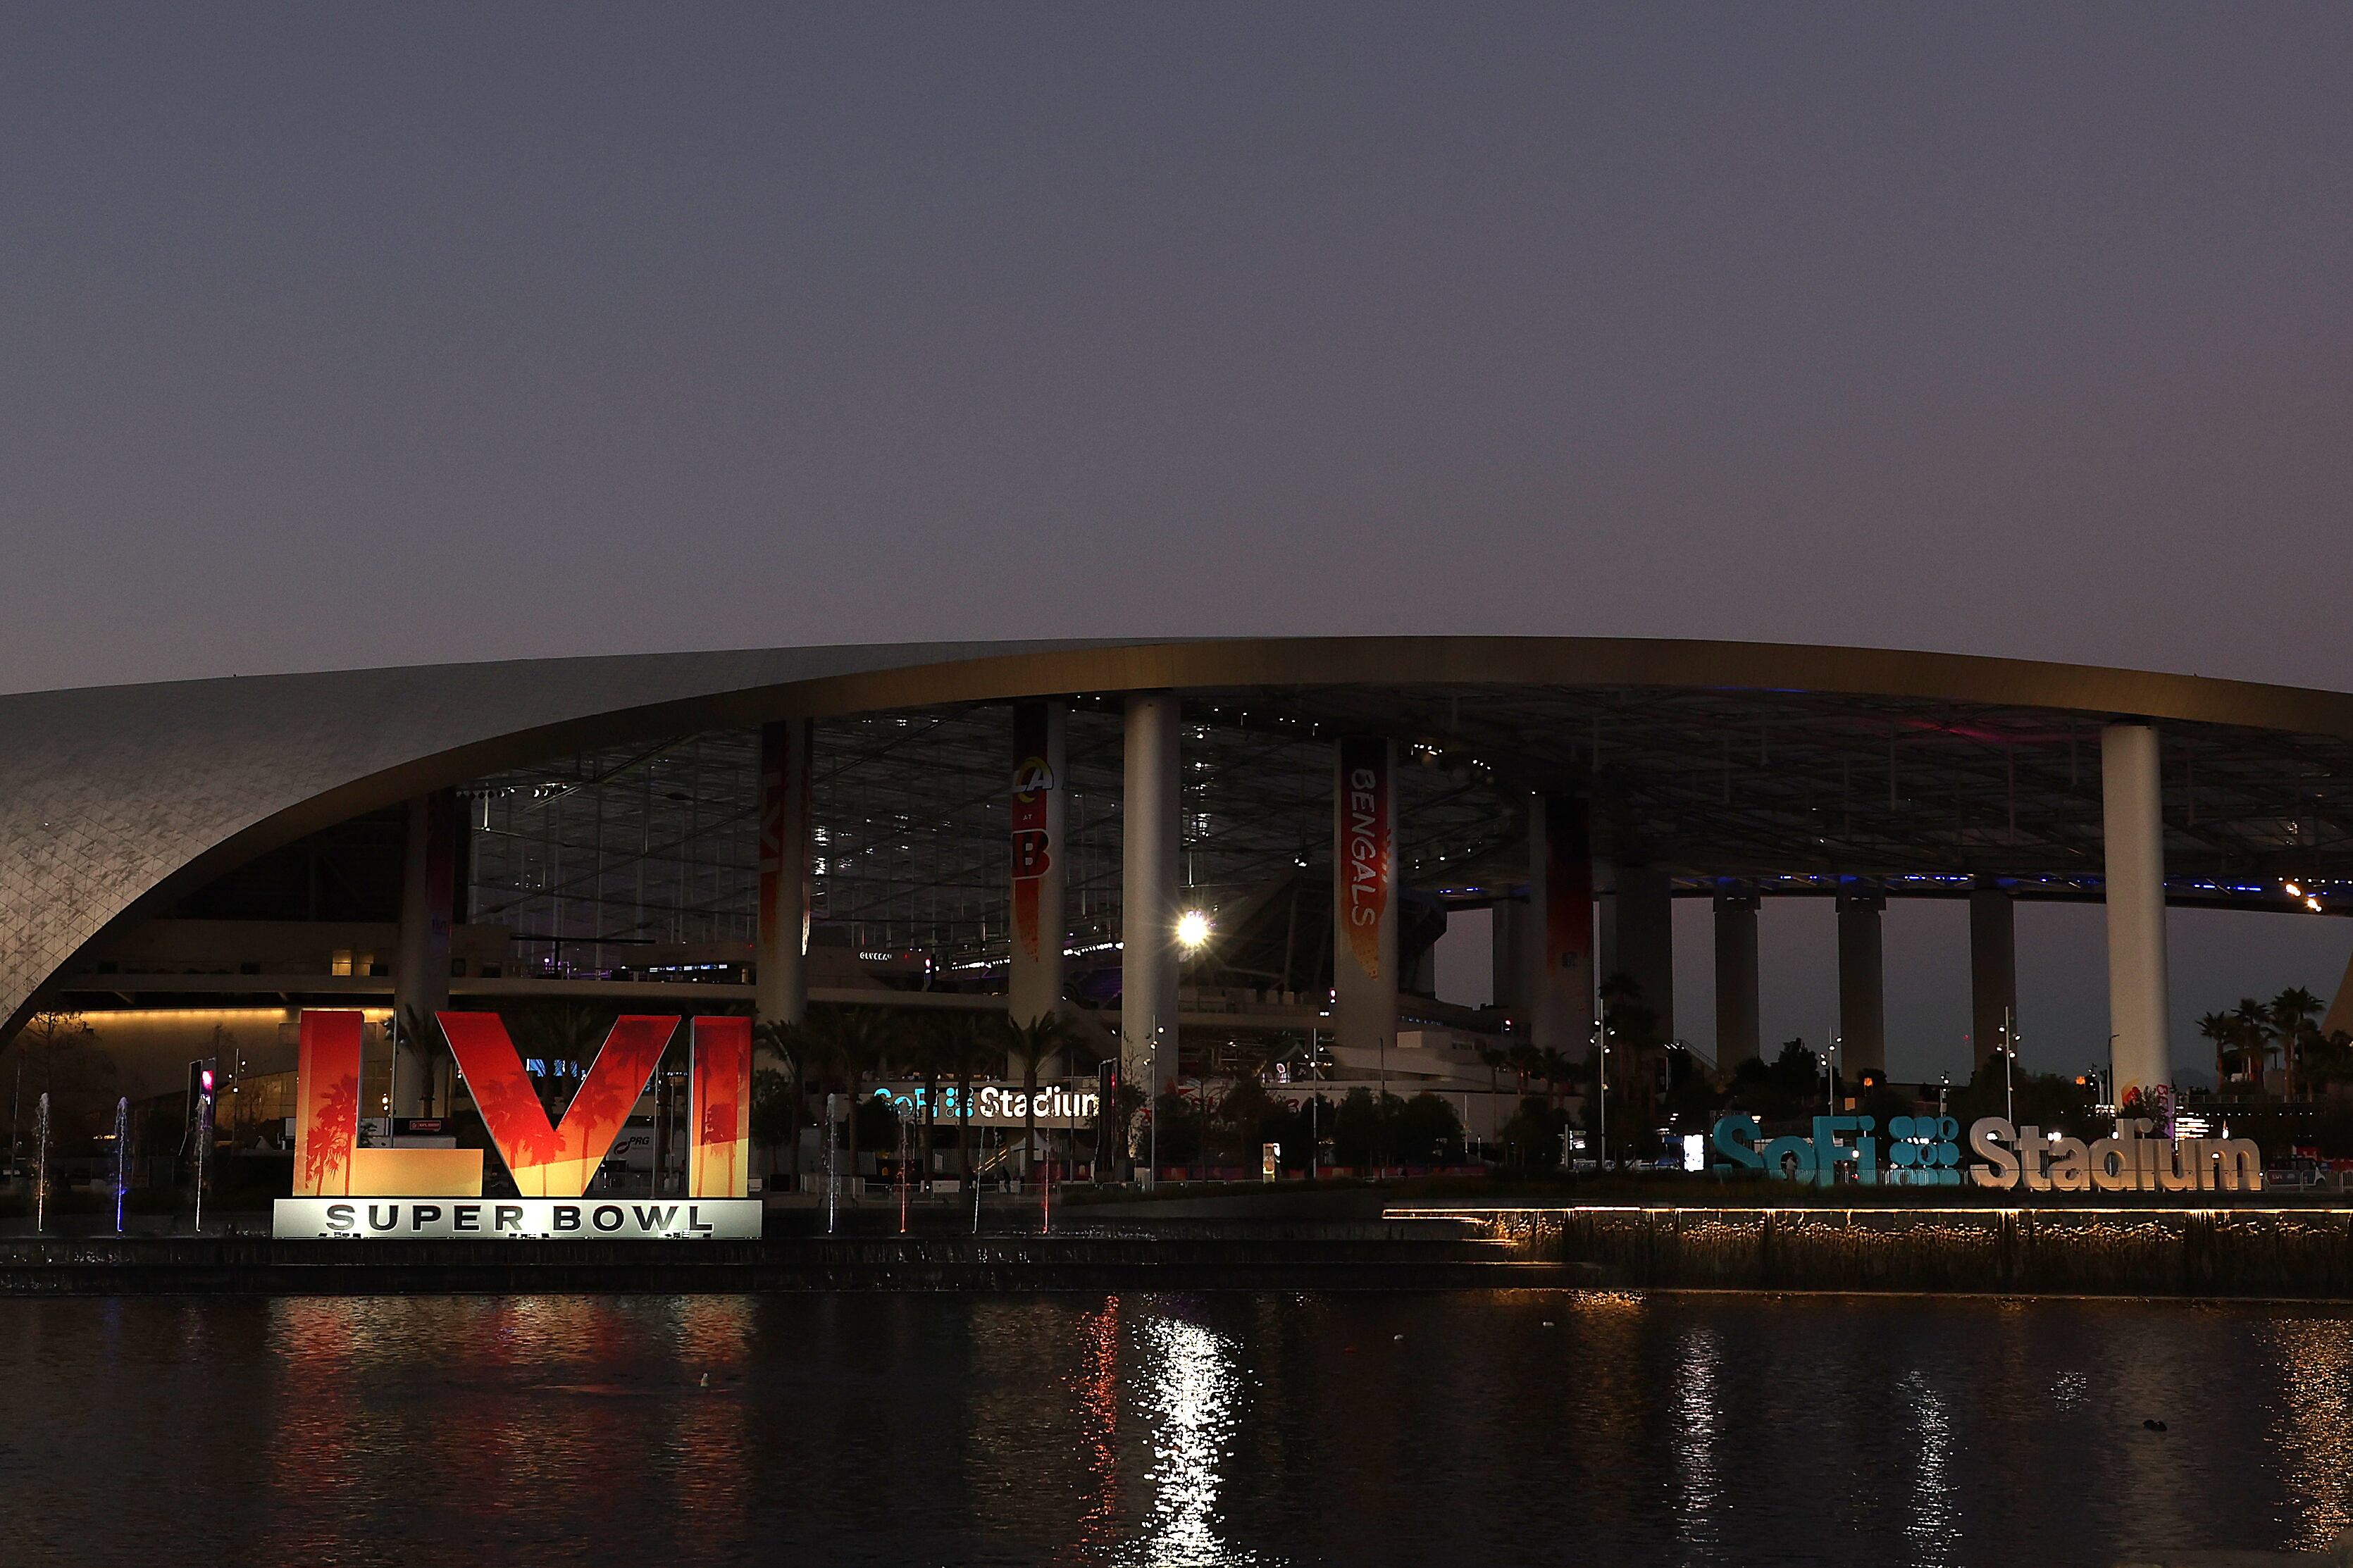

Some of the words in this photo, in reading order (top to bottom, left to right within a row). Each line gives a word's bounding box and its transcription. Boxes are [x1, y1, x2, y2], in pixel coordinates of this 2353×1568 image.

[1011, 828, 1050, 878] B
[1351, 768, 1377, 927] BENGALS
[293, 1010, 751, 1197] LVI
[629, 1137, 650, 1145] PRG
[1713, 1115, 1878, 1188] SoFi
[1969, 1116, 2263, 1192] Stadium
[326, 1204, 523, 1232] SUPER
[552, 1205, 714, 1233] BOWL
